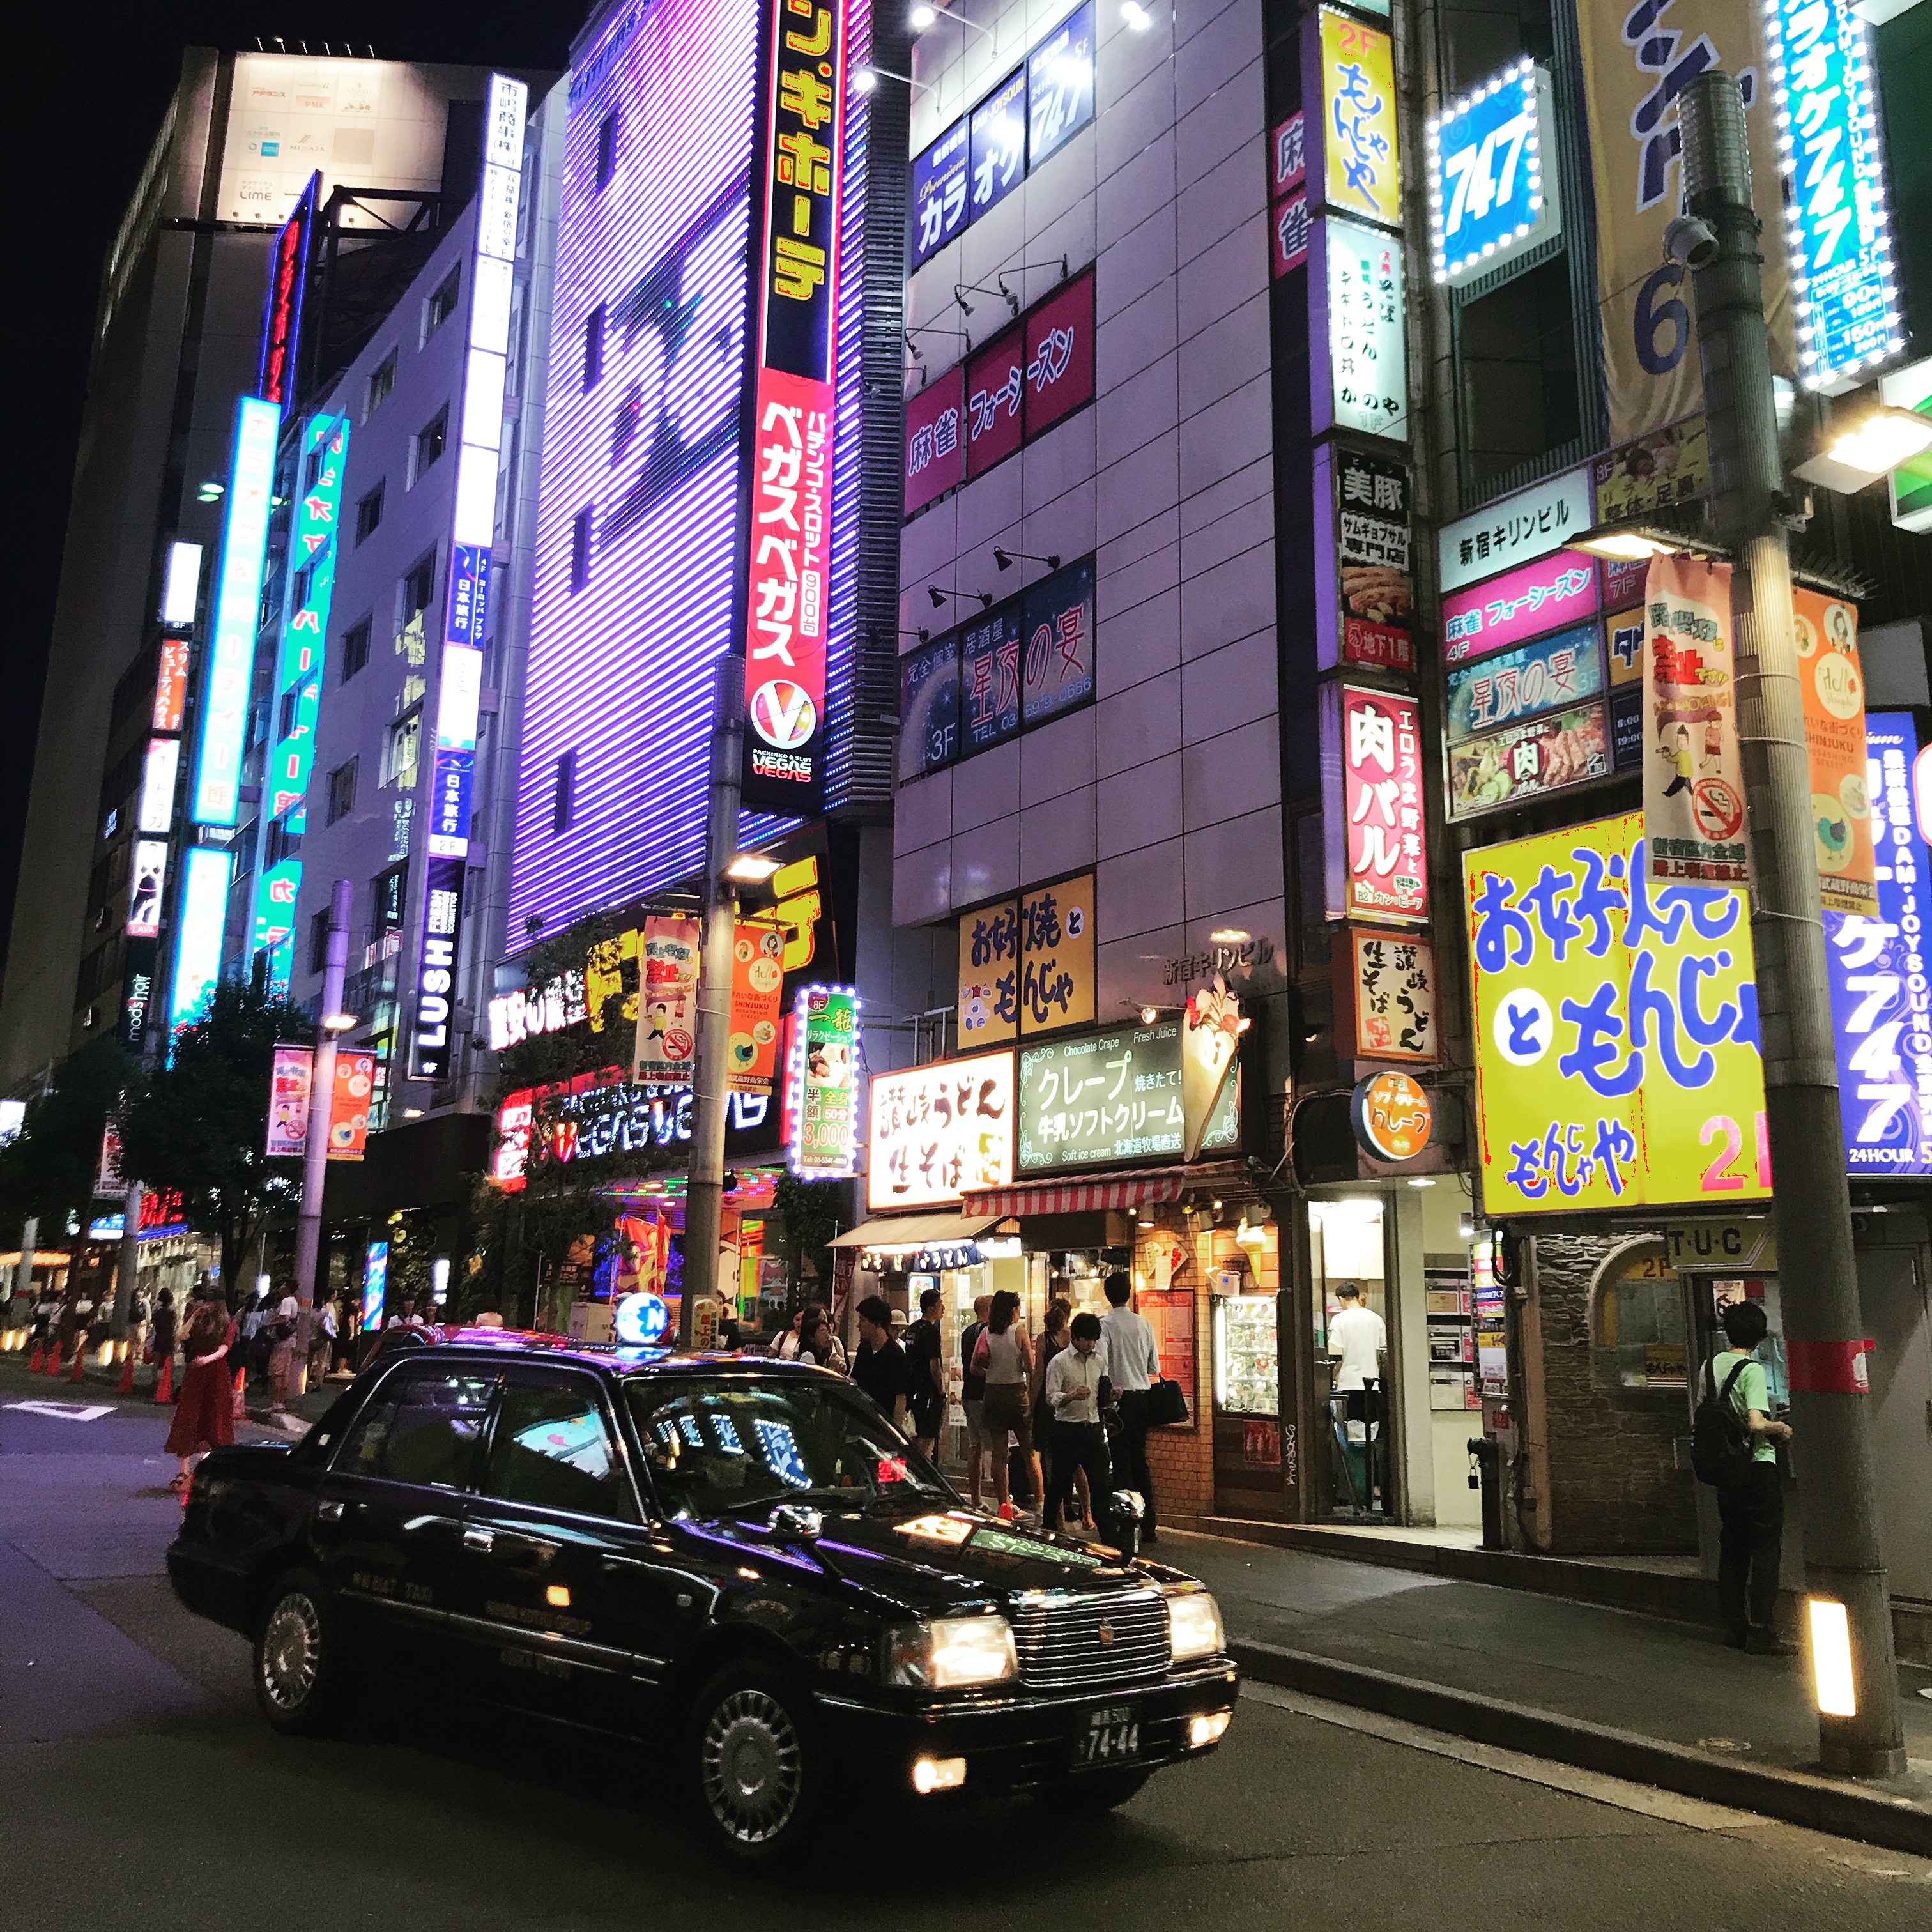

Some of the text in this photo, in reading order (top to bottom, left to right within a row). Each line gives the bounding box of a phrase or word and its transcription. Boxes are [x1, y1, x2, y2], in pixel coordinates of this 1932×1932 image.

[1338, 23, 1379, 59] 2F
[1333, 63, 1389, 213] もんじゃや
[1445, 114, 1528, 238] 747
[240, 192, 272, 201] LIME
[908, 326, 1075, 477] 麻雀 フォーシーズン
[1342, 386, 1399, 417] かのや
[804, 411, 825, 567] パチンコ・スロット
[1344, 467, 1403, 512] 美豚
[753, 401, 804, 667] ベガスベガス
[1346, 537, 1406, 565] 専門店
[1459, 498, 1569, 567] 新宿キリンビル
[454, 579, 471, 630] 日本旅行
[474, 579, 486, 640] ヨーロッパ プラザ
[1446, 567, 1591, 642] 麻雀 フォーシーズン
[965, 618, 1003, 655] 居酒屋
[1447, 640, 1469, 661] 4F
[175, 641, 189, 677] スリム
[907, 642, 956, 686] 完全個室
[970, 604, 1084, 728] 星夜の宴
[156, 647, 176, 729] ビューティハウス
[1473, 652, 1576, 728] 星夜の宴
[172, 714, 180, 729] 6F
[973, 724, 996, 743] TEL
[753, 749, 788, 758] PACHINKO
[931, 723, 956, 760] 3F
[752, 763, 811, 783] VEGAS
[753, 754, 812, 773] VEGAS
[442, 774, 460, 833] 日本旅行
[1349, 704, 1401, 876] 肉バル
[1399, 710, 1422, 875] エロうま野菜と
[439, 839, 457, 852] 2F
[428, 889, 444, 933] FRESH
[447, 892, 457, 934] COSMETICS
[1358, 889, 1368, 901] B2
[132, 924, 155, 935] LAVA
[1163, 937, 1276, 986] 新宿キリンビル
[1363, 941, 1390, 1014] 生そば
[418, 940, 454, 1047] LUSH
[735, 1000, 769, 1010] SHINJUKU
[813, 999, 824, 1009] 8F
[994, 958, 1074, 1024] もんじゃ
[1394, 945, 1430, 1052] 讃岐うどん
[807, 1029, 854, 1044] リラクゼーション
[809, 1008, 853, 1033] 一龍
[1064, 1026, 1177, 1057] Chocolate Crape Fresh Juice
[422, 1062, 438, 1074] 1F
[1038, 1050, 1183, 1110] クレープ 焼きたて!
[807, 1088, 821, 1122] 半額
[824, 1090, 850, 1106] 全身
[825, 1108, 849, 1121] 50分
[880, 1075, 1007, 1140] 讃岐うどん
[803, 1122, 850, 1149] 3,000
[1038, 1096, 1186, 1145] 牛乳ソフトクリーム
[1372, 1107, 1431, 1134] クレープ
[1062, 1147, 1112, 1162] Soft ice cream
[1114, 1132, 1182, 1157] 北海道牧場直送
[1849, 1148, 1915, 1163] 24HOUR
[891, 1141, 967, 1195] 生そば
